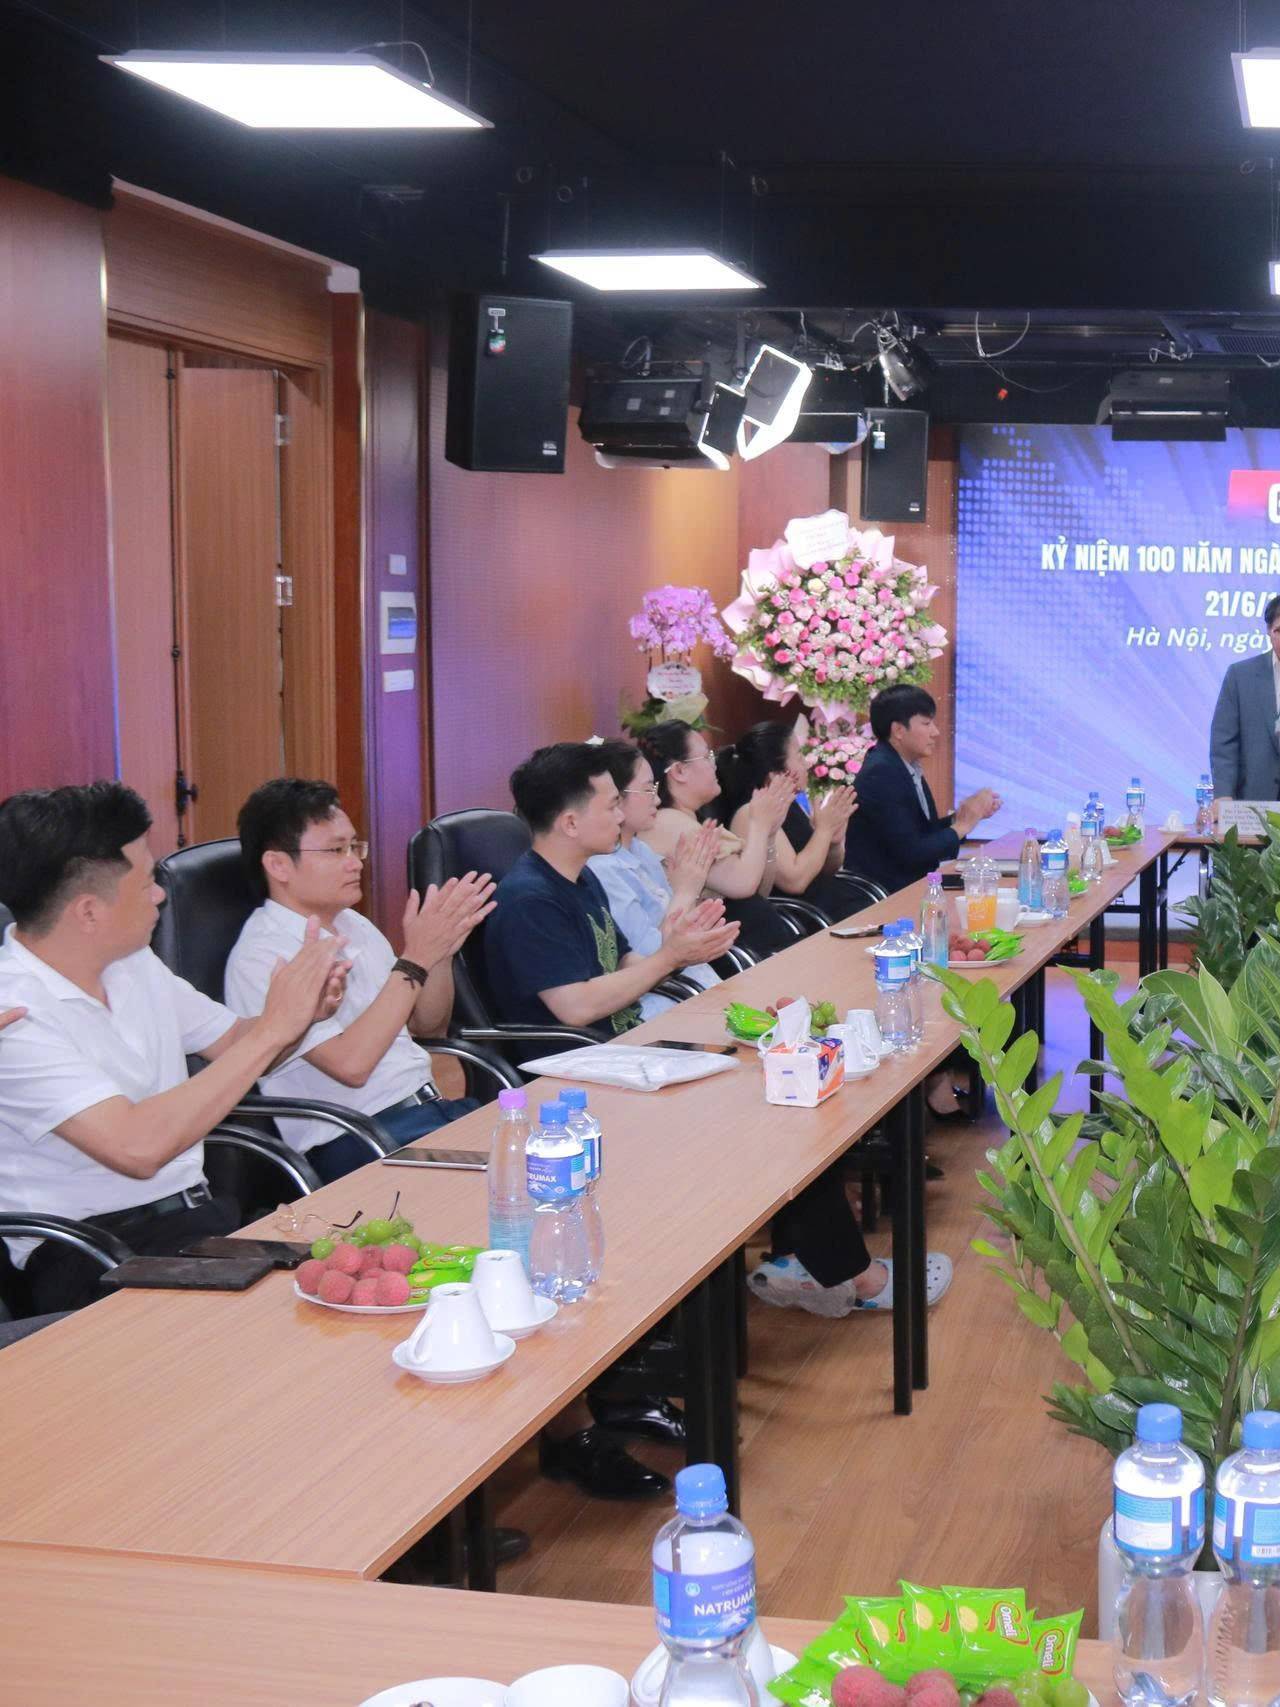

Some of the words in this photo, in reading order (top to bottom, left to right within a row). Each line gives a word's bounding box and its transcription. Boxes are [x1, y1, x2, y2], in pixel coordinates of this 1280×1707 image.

[1041, 536, 1068, 571] KỶ
[1075, 538, 1129, 577] NIỆM
[1136, 546, 1176, 572] 100
[1182, 540, 1232, 573] NĂM
[1127, 626, 1160, 647] Hà
[1167, 626, 1212, 651] Nội,
